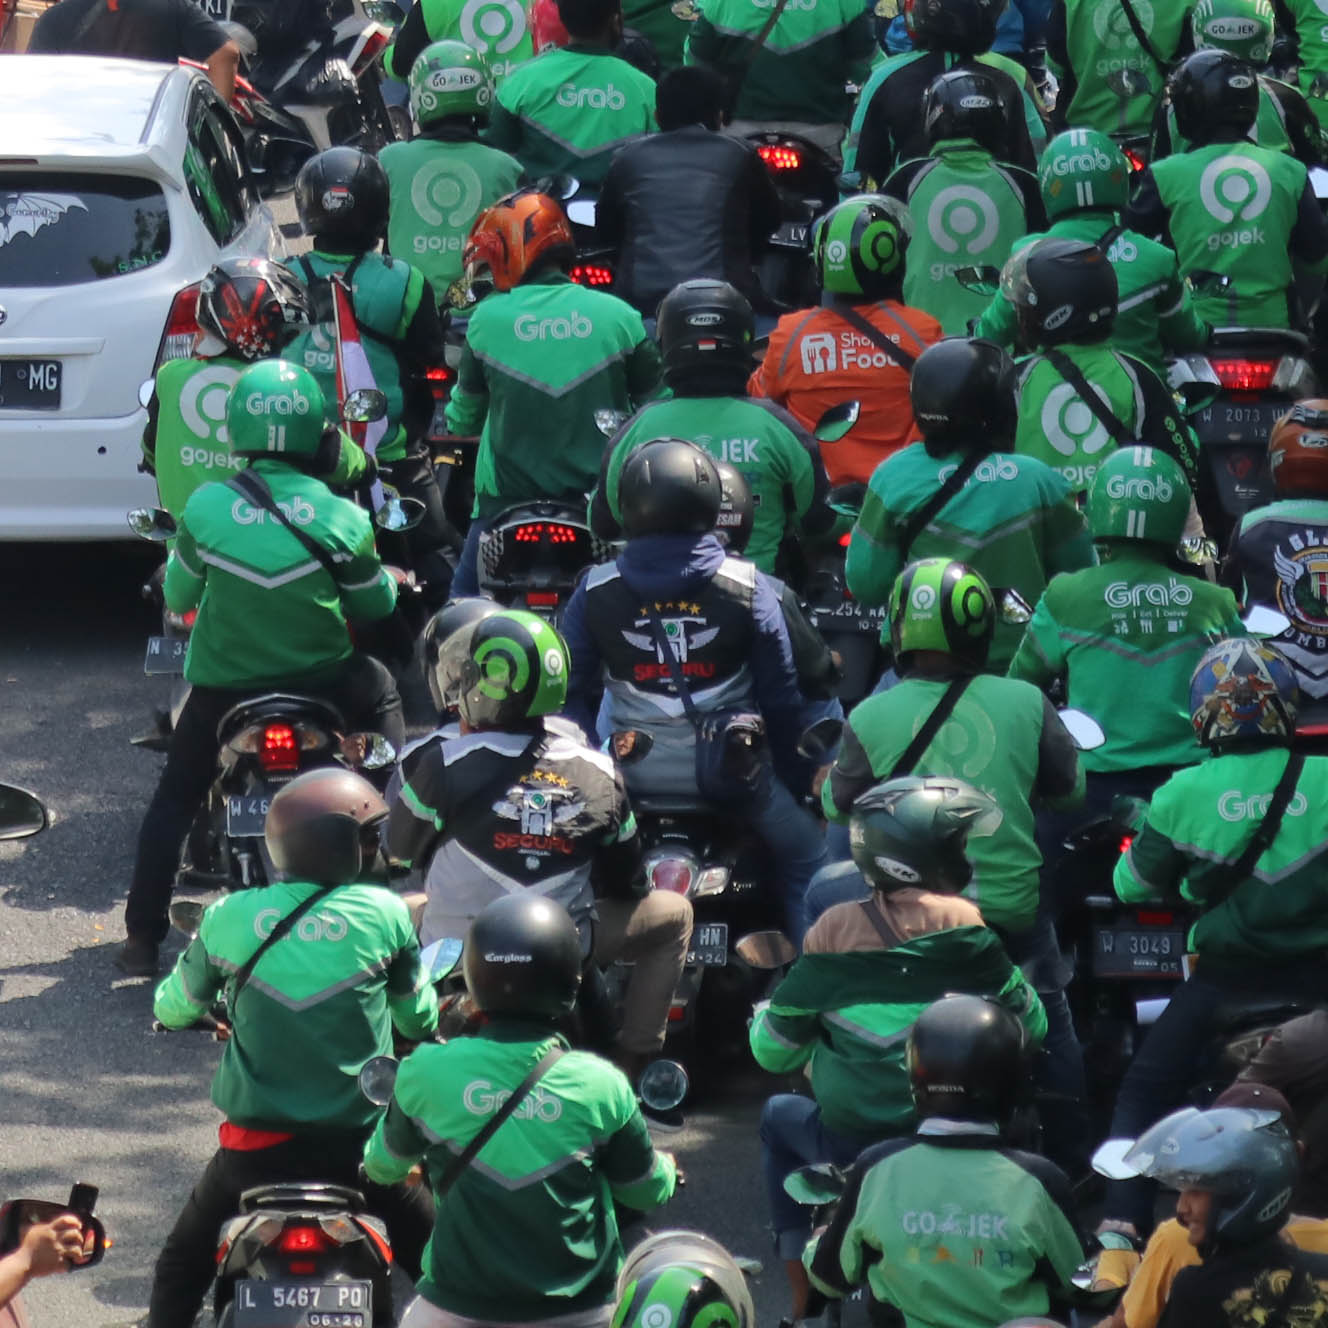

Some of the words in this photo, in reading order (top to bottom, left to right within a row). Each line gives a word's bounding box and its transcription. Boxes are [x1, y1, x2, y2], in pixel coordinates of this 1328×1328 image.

[556, 82, 626, 111] Grab
[1053, 147, 1111, 176] Grab
[1208, 226, 1265, 251] gojek
[514, 310, 593, 342] Grab
[842, 333, 901, 354] Shoe
[29, 365, 57, 391] MG
[246, 389, 310, 416] Grab
[1226, 408, 1262, 423] 2073
[180, 446, 244, 471] gojek
[1106, 475, 1174, 503] Grab
[1105, 577, 1193, 609] Grab
[232, 800, 242, 817] W
[254, 908, 348, 942] Gab
[700, 928, 721, 946] HN
[1130, 936, 1171, 954] 3049
[903, 1211, 937, 1235] GO
[966, 1213, 1009, 1240] JEK
[245, 1288, 257, 1308] L
[273, 1287, 322, 1308] 5467
